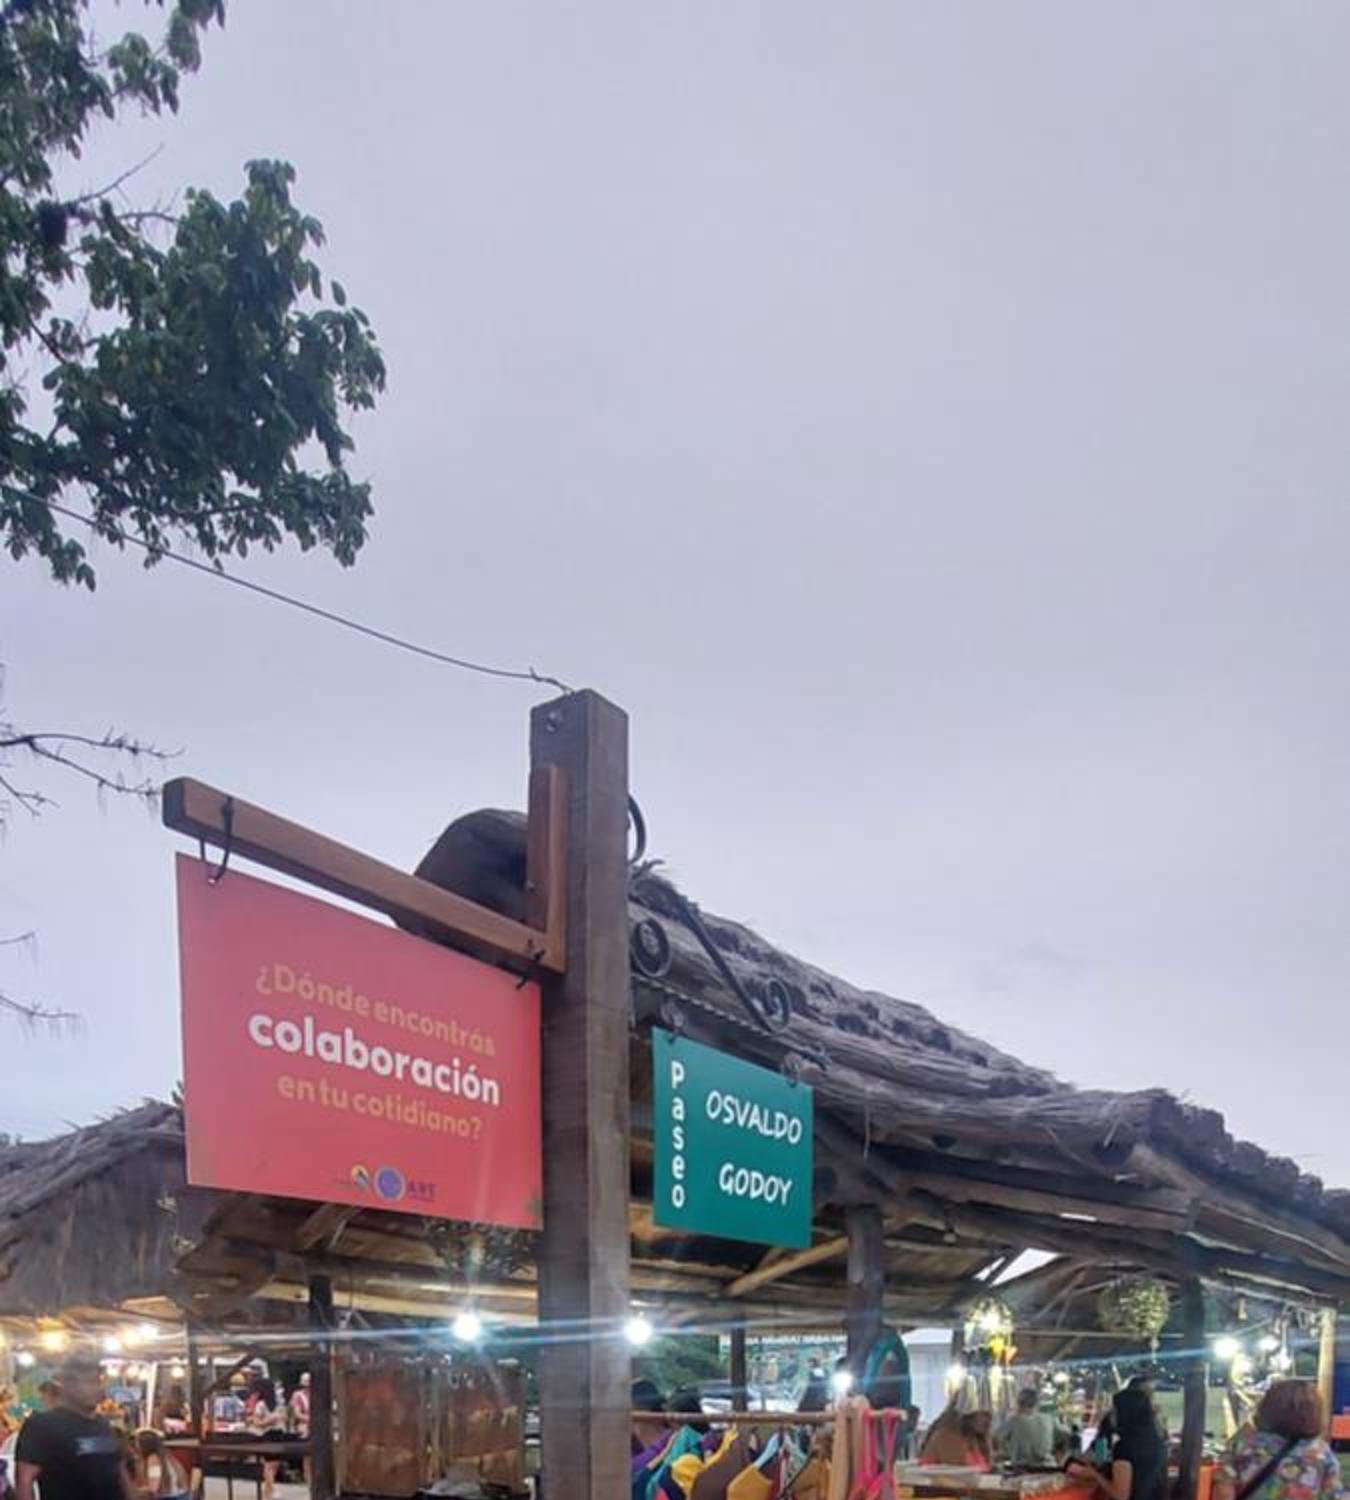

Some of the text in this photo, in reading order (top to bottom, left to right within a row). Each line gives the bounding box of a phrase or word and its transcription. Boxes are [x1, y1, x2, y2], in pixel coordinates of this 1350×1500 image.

[256, 964, 497, 1057] ¿Dónde encontrás
[249, 1013, 499, 1107] colaboración
[277, 1074, 482, 1140] en tu cotidiano?
[671, 1060, 685, 1208] Paseo
[706, 1089, 803, 1145] OSVALDO
[718, 1162, 793, 1206] GODOY
